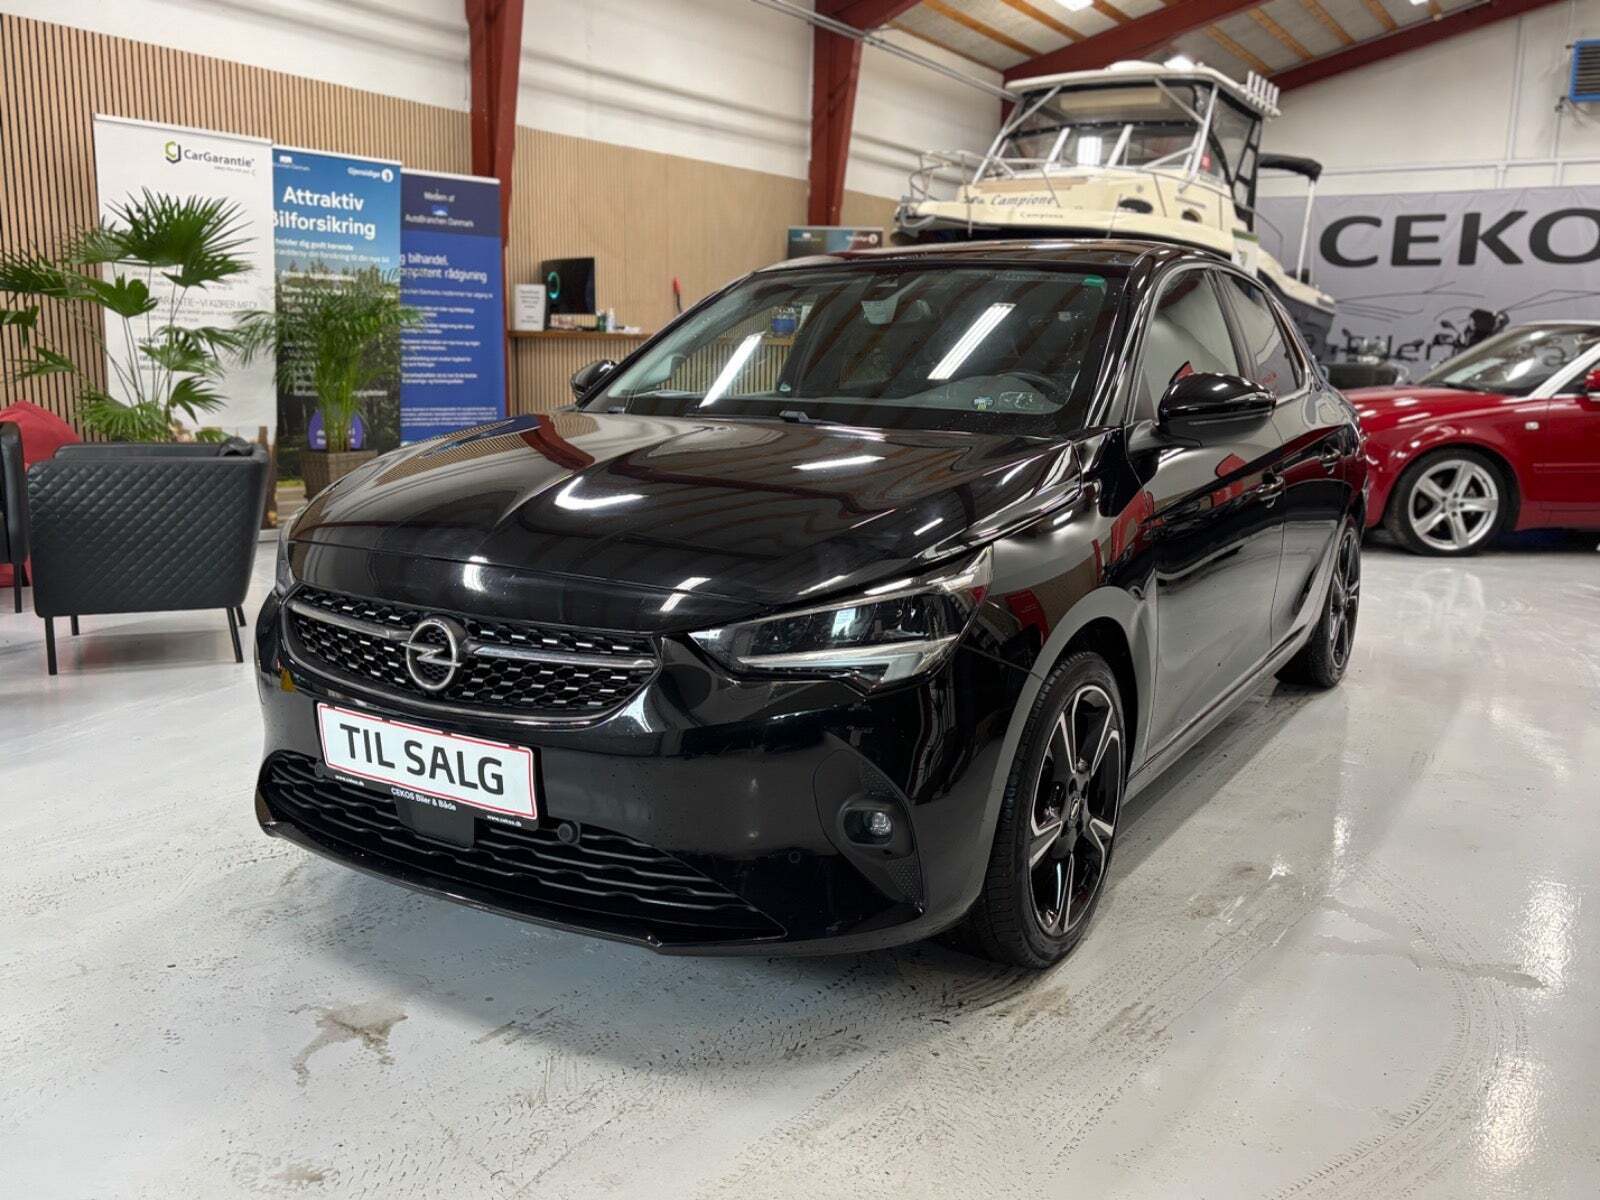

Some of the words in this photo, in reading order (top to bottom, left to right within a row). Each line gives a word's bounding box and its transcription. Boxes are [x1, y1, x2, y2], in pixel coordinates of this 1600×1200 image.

[184, 149, 252, 168] CarGarantie
[283, 186, 364, 211] Attraktiv
[339, 723, 395, 769] TIL
[404, 740, 504, 796] SALG
[391, 787, 415, 801] CEKOS
